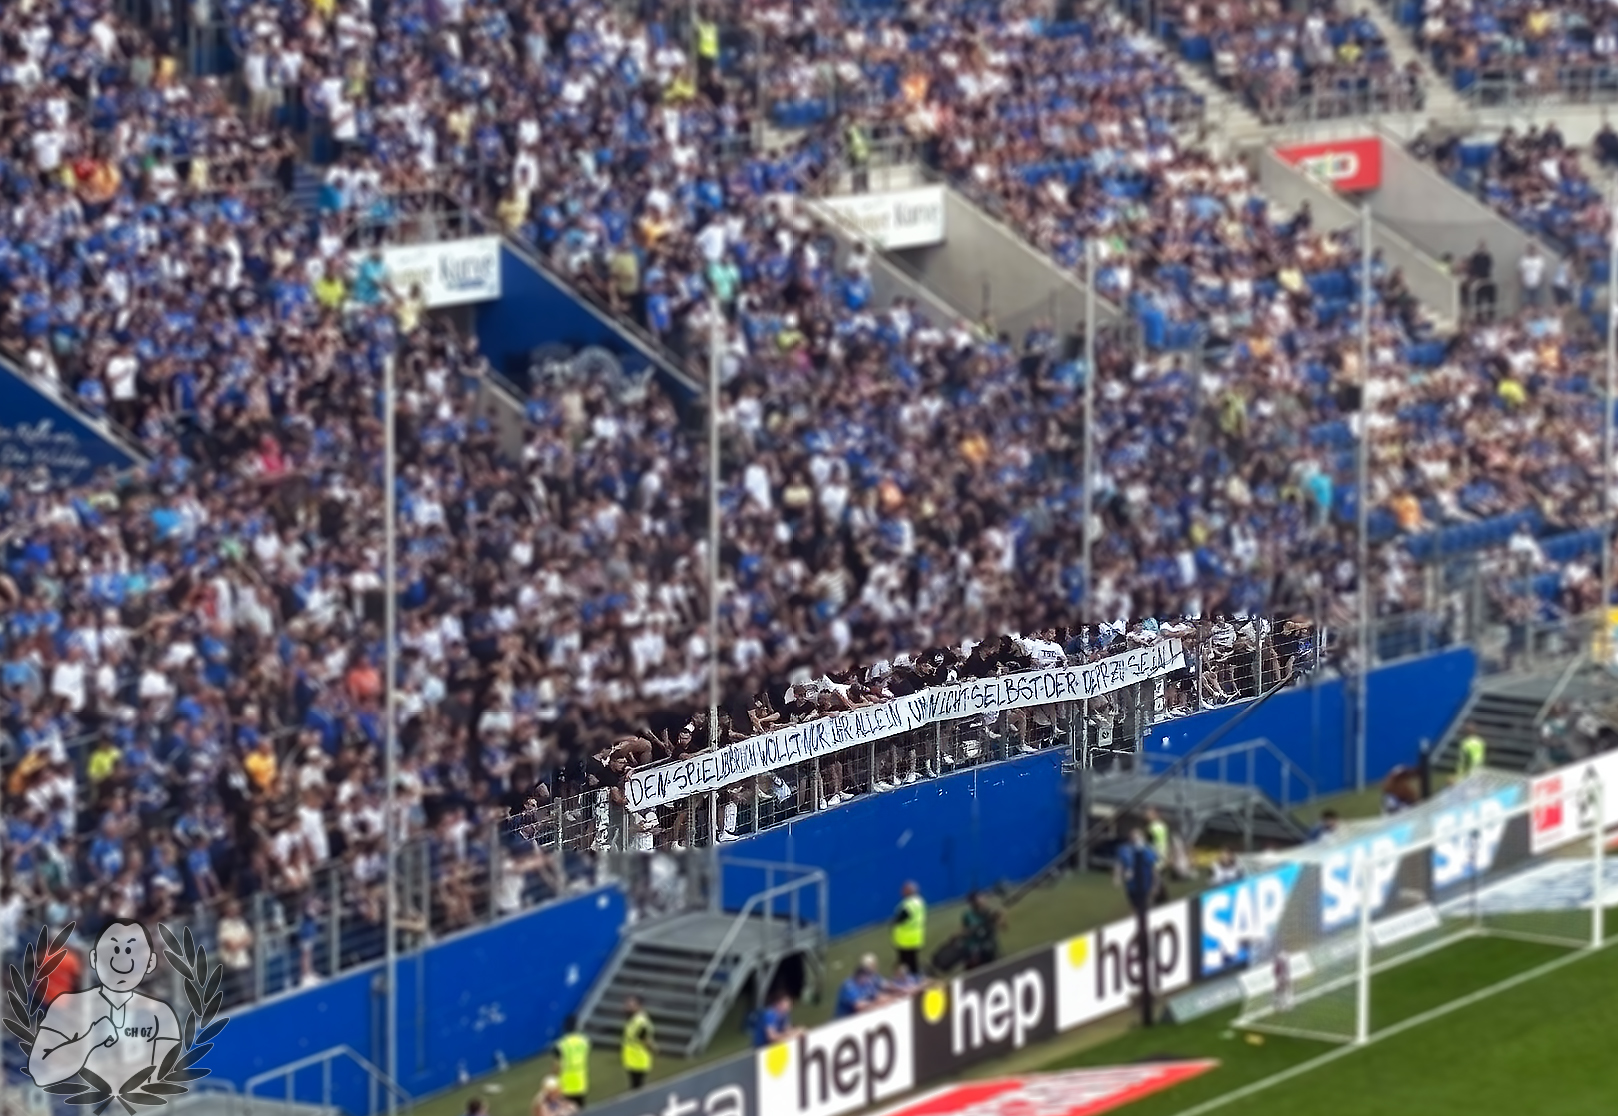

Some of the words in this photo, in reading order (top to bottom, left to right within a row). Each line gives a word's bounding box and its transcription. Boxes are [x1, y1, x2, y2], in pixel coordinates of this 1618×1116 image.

[630, 771, 669, 806] DEN
[804, 723, 831, 756] NUR
[971, 675, 1043, 709] SELBST
[1044, 672, 1077, 698] DER
[1202, 873, 1284, 973] SAP
[1322, 838, 1402, 925] SAP
[1097, 921, 1180, 1001] hep
[952, 969, 1044, 1056] hep
[799, 1023, 896, 1111] hep
